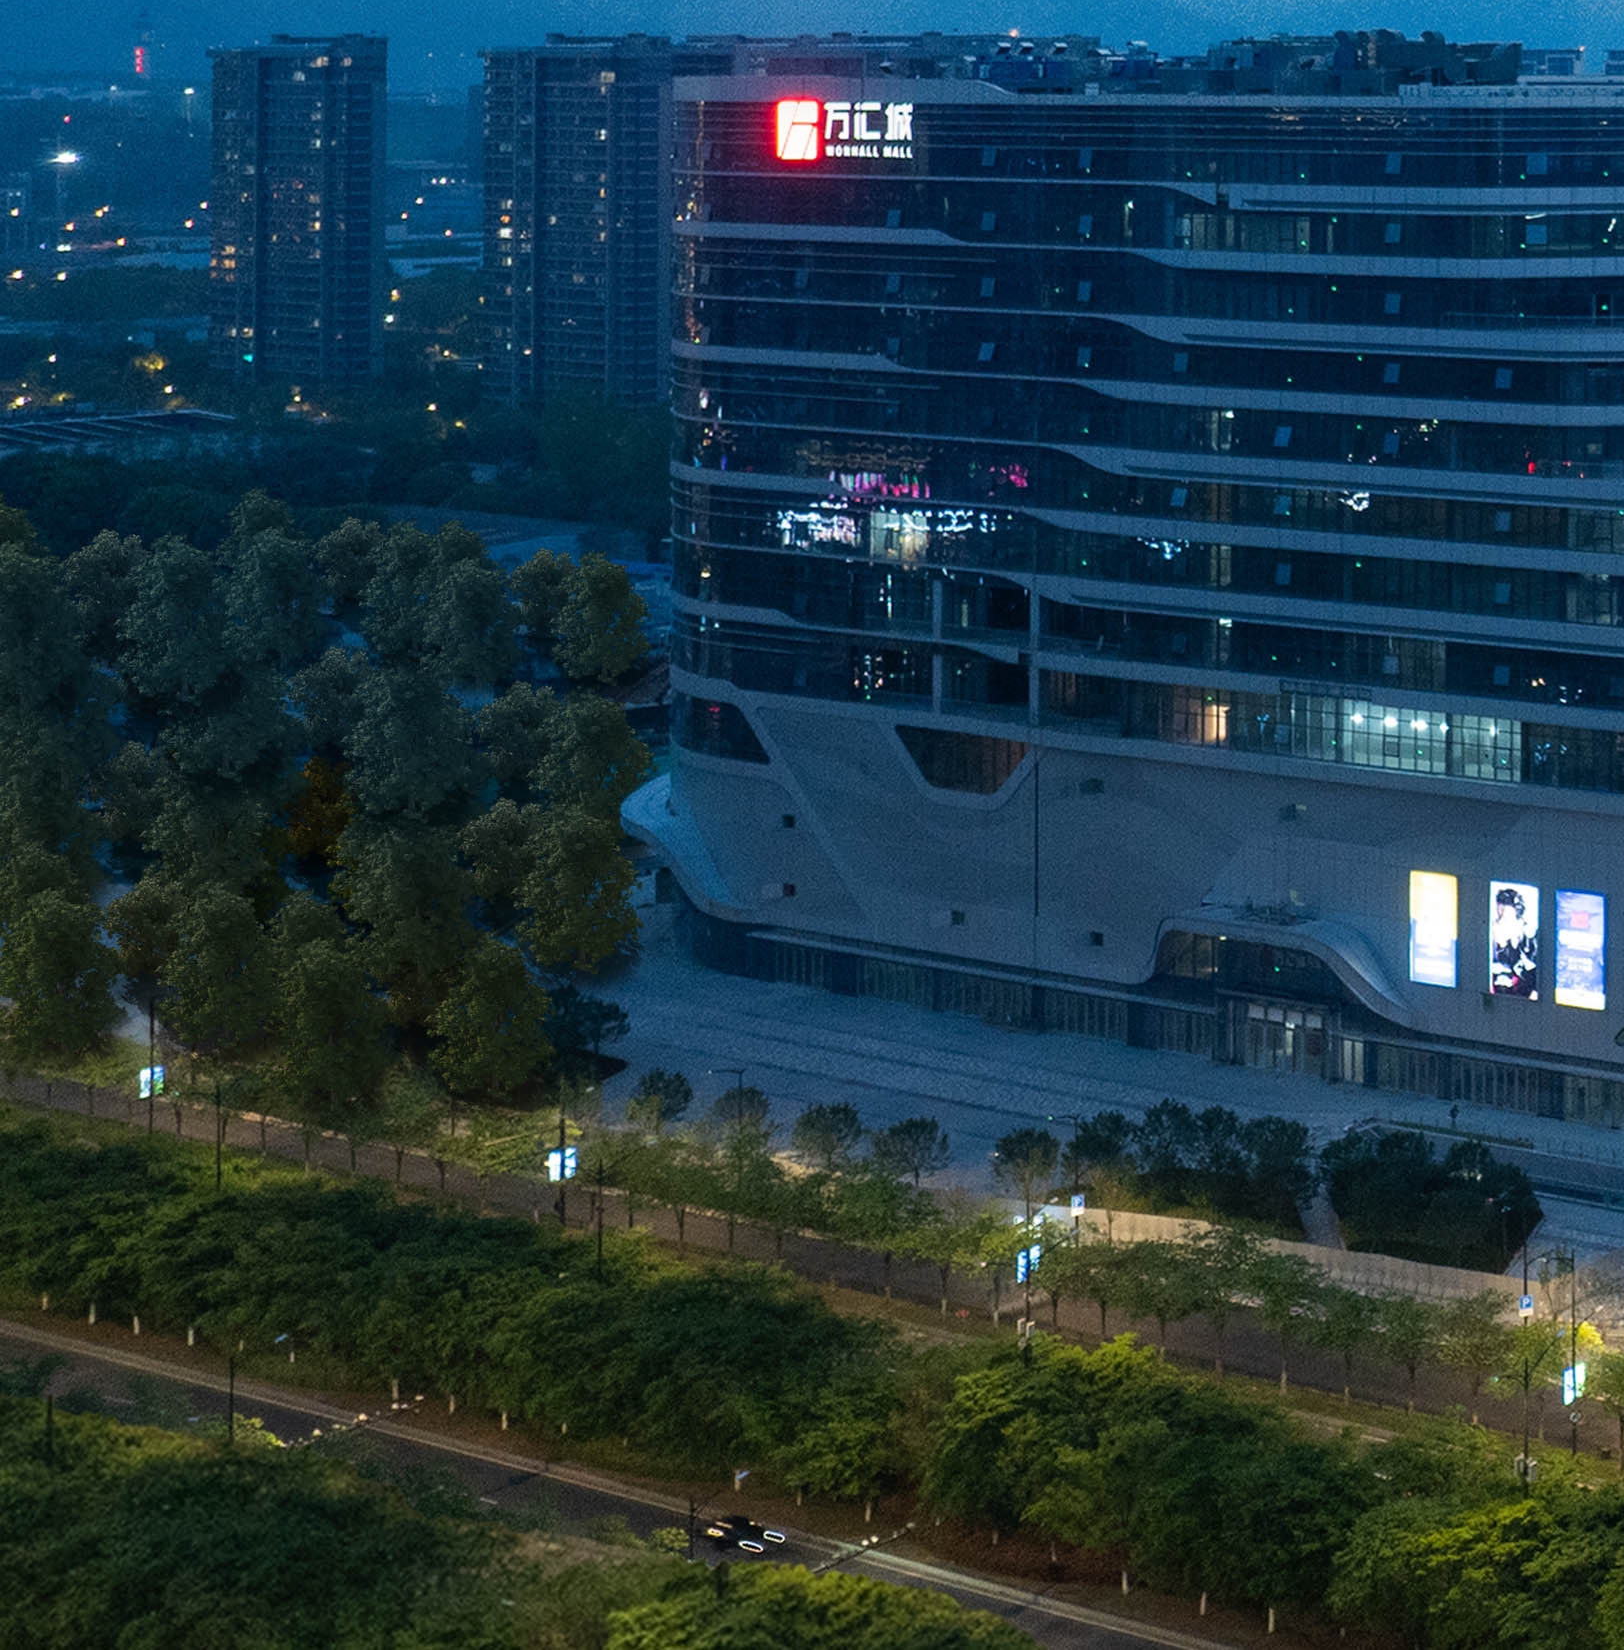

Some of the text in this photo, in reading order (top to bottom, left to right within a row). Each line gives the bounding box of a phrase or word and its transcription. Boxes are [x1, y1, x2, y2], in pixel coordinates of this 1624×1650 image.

[824, 102, 913, 140] 万汇城
[825, 145, 913, 159] WONHALL MALL
